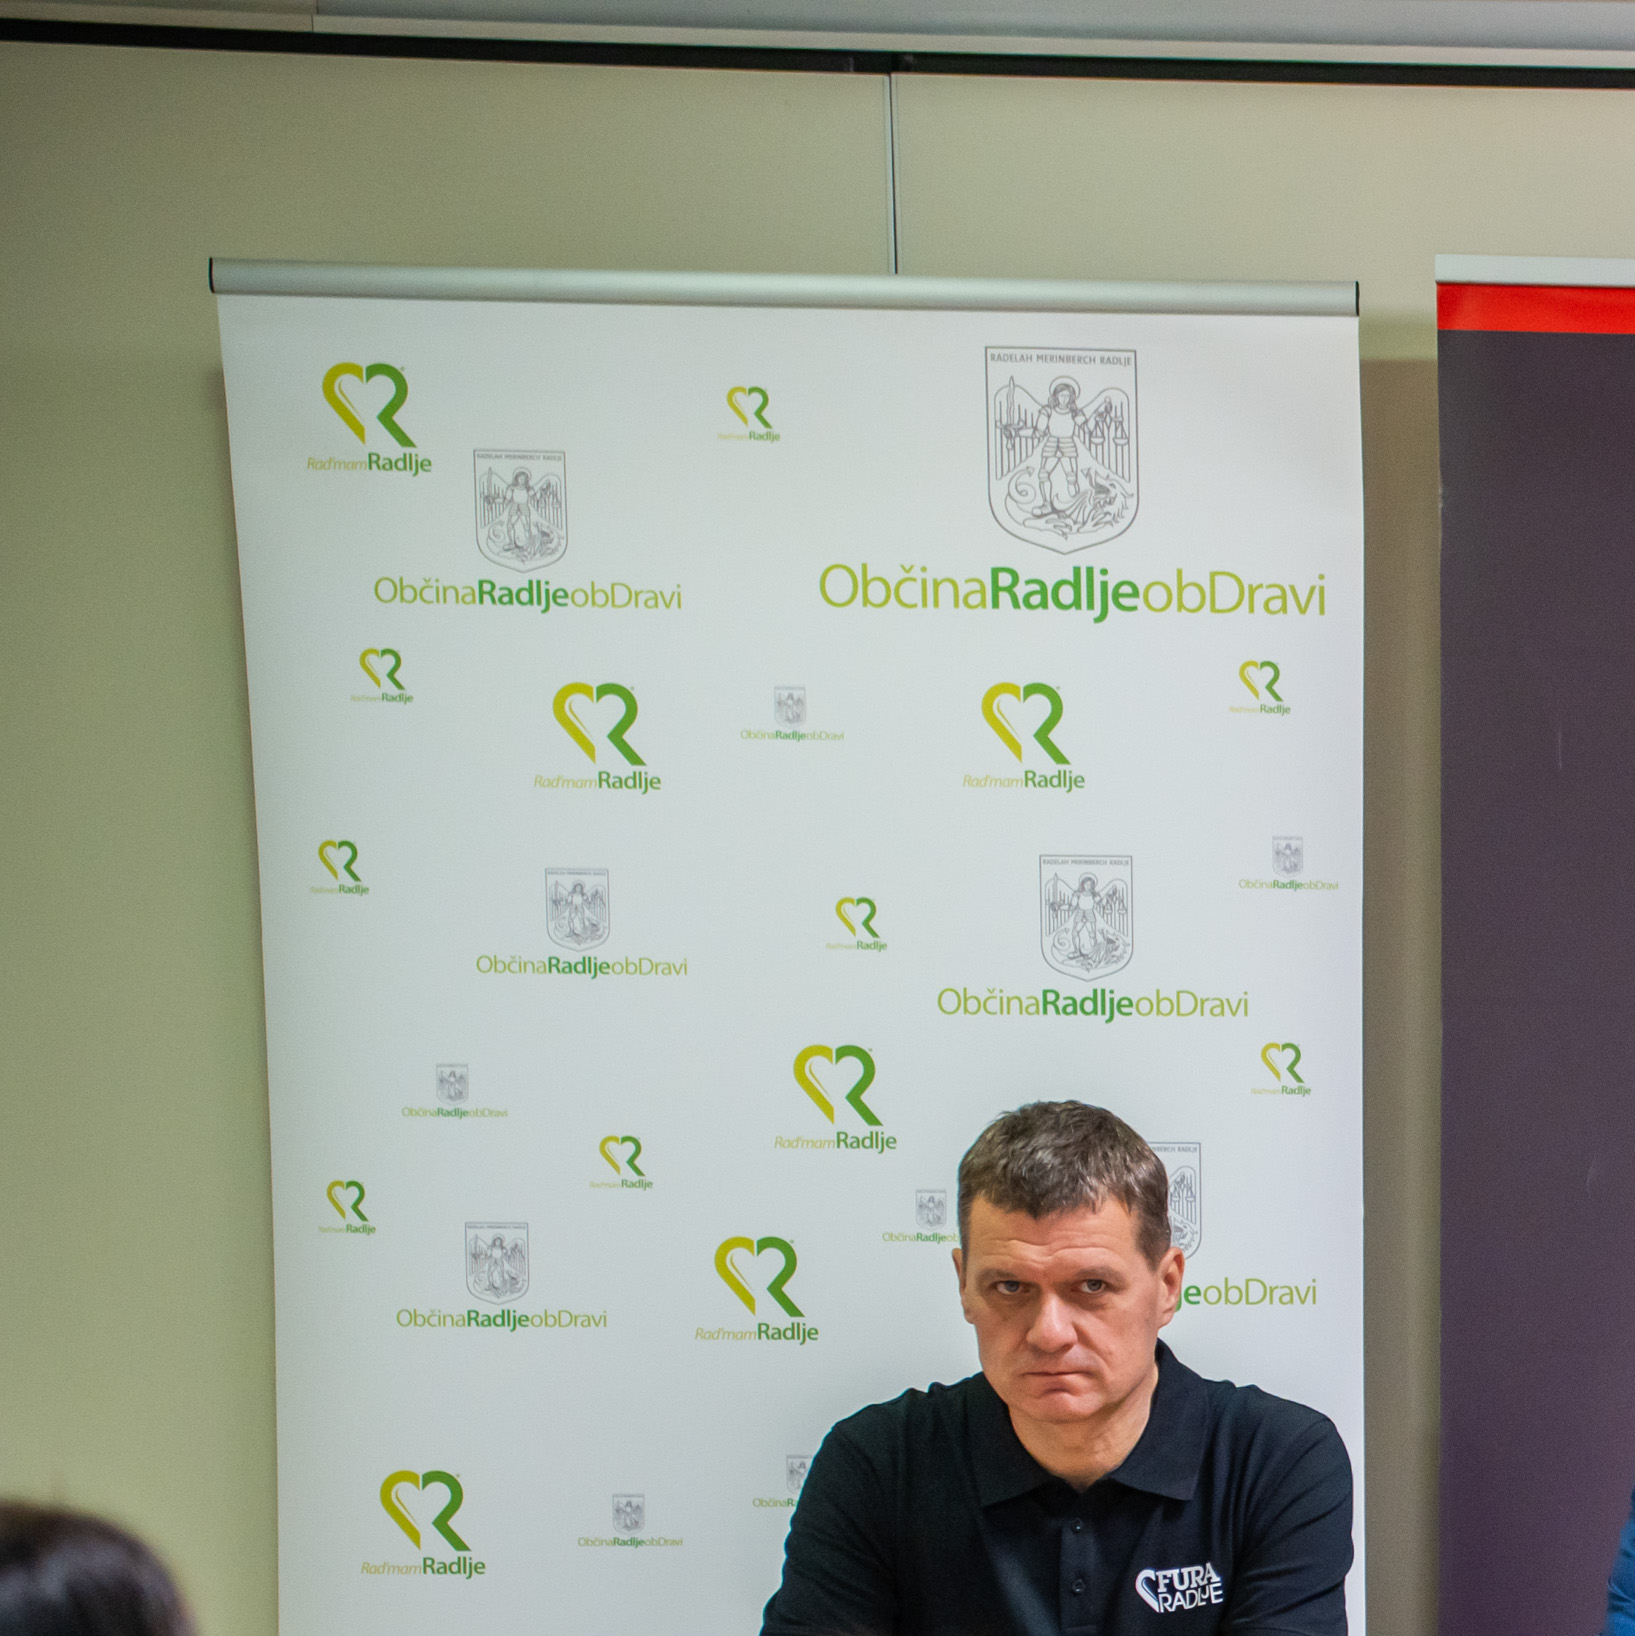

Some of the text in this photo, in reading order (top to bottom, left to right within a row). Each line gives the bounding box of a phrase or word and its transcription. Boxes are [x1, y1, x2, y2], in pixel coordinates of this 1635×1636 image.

[1100, 356, 1132, 367] RADLJE
[374, 576, 683, 615] ObčinaRadljeobDravi
[819, 562, 1327, 625] ObčinaRadljeobDravi
[937, 986, 1250, 1025] ObčinaRadljeobDravi
[1156, 1562, 1220, 1593] FURA
[1158, 1583, 1223, 1613] RADLJE
